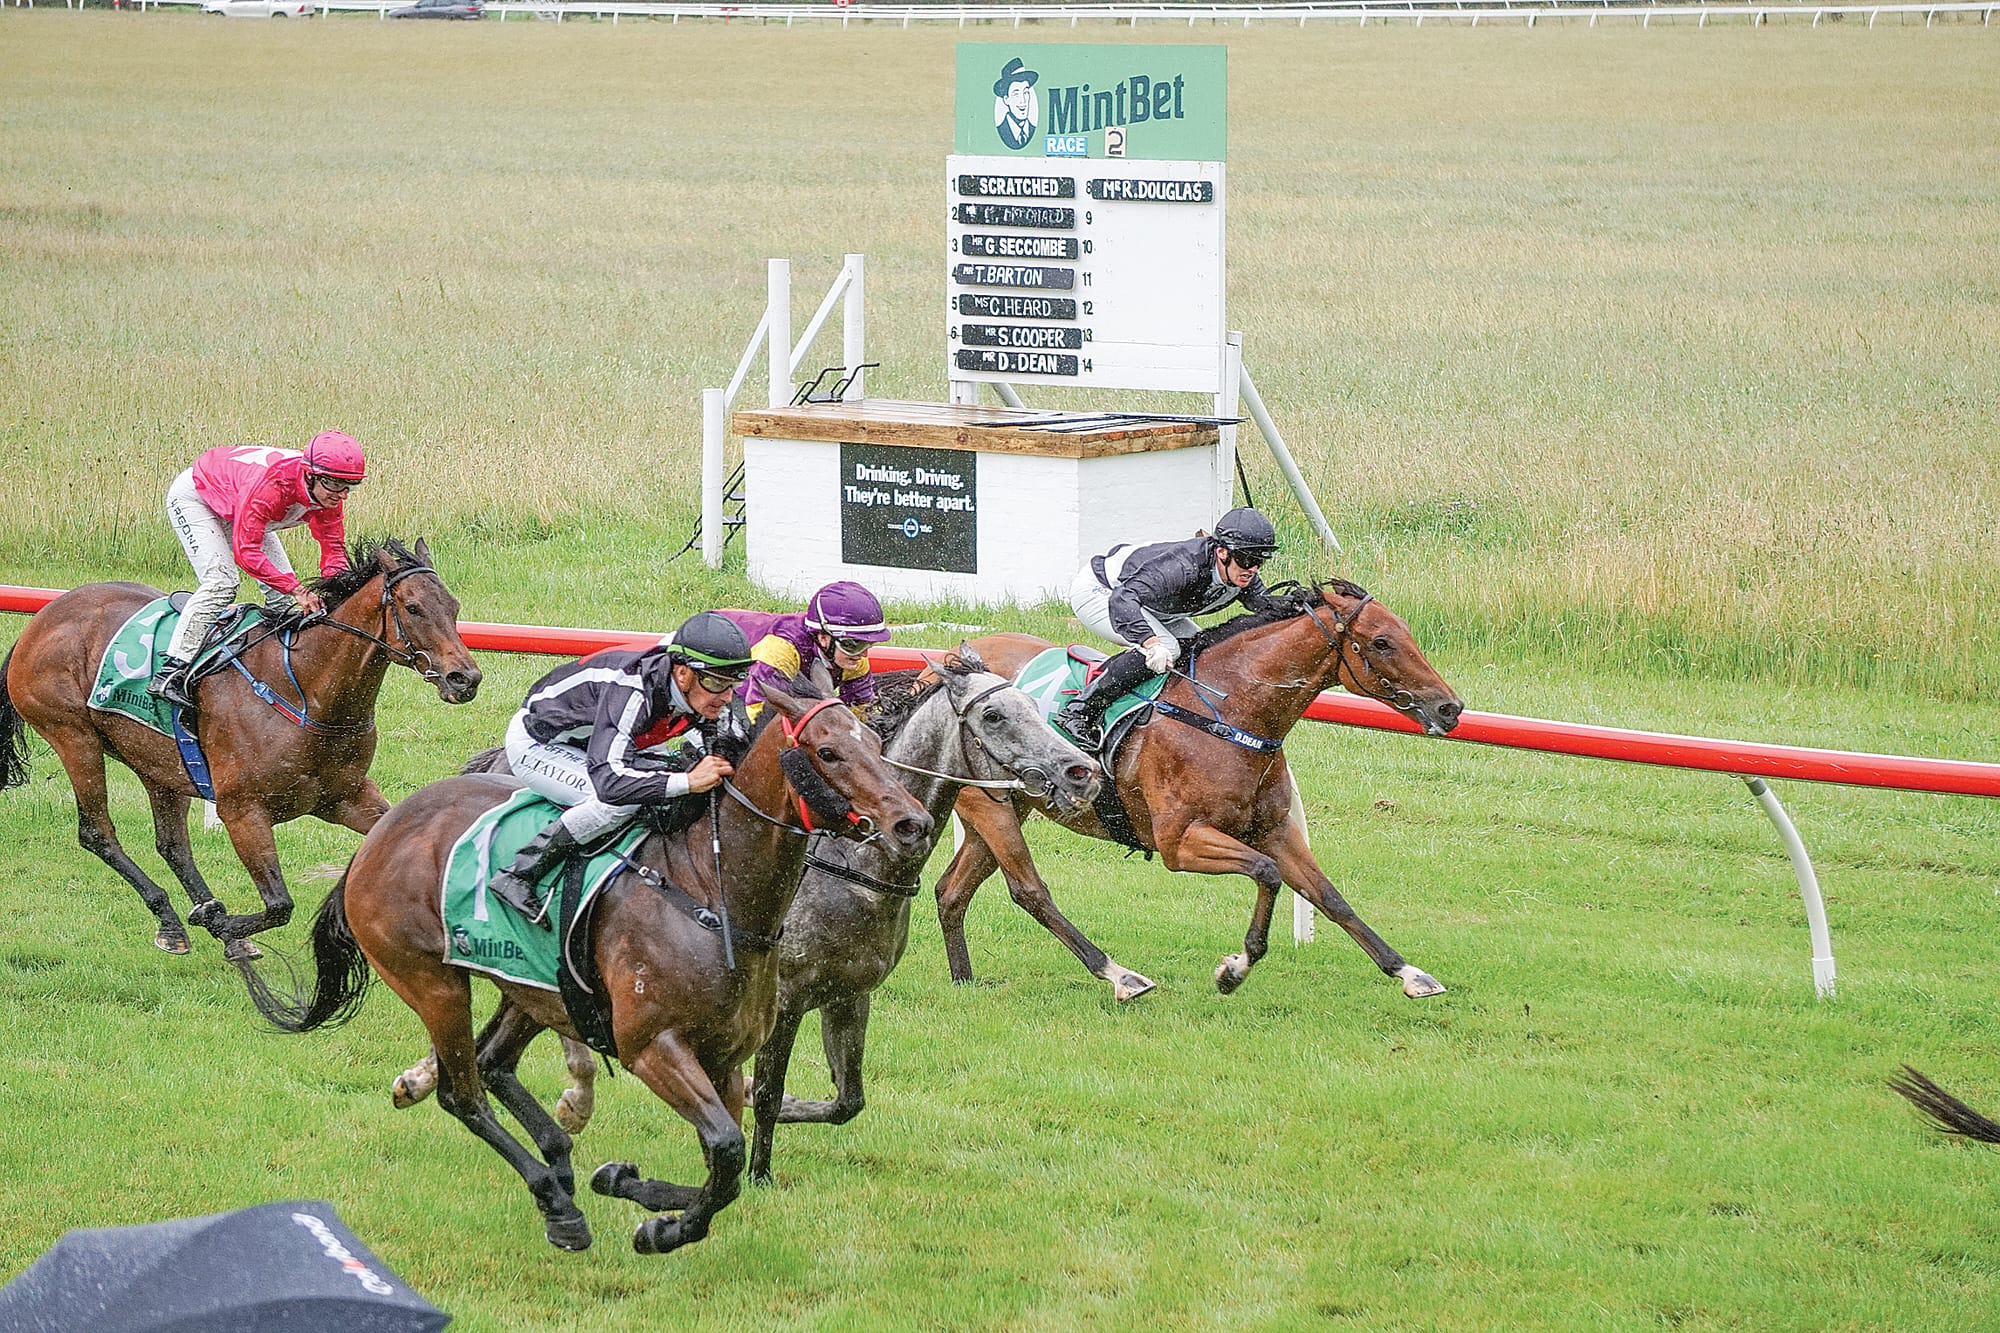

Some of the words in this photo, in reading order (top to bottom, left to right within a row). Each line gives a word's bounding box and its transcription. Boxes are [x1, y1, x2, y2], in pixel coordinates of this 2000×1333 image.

[1047, 73, 1185, 135] MintBet
[1046, 137, 1086, 153] RACE
[1107, 130, 1123, 155] 2
[951, 178, 957, 193] 1
[979, 177, 1059, 196] SCRATCHED
[1086, 180, 1092, 194] 8
[951, 206, 958, 221] 2
[1085, 211, 1092, 225] 9
[951, 238, 958, 252] 3
[1082, 239, 1093, 255] 10
[962, 266, 974, 275] MR
[1082, 271, 1092, 287] 11
[951, 296, 958, 311] 5
[1082, 300, 1094, 316] 12
[950, 326, 957, 340] 6
[1082, 328, 1093, 343] 13
[1082, 358, 1093, 373] 14
[855, 463, 912, 487] Drinking.
[915, 467, 964, 490] Driving.
[893, 489, 933, 508] better
[935, 494, 975, 513] apart.
[472, 820, 501, 922] 1
[474, 938, 529, 962] MitBe
[635, 980, 645, 994] 8
